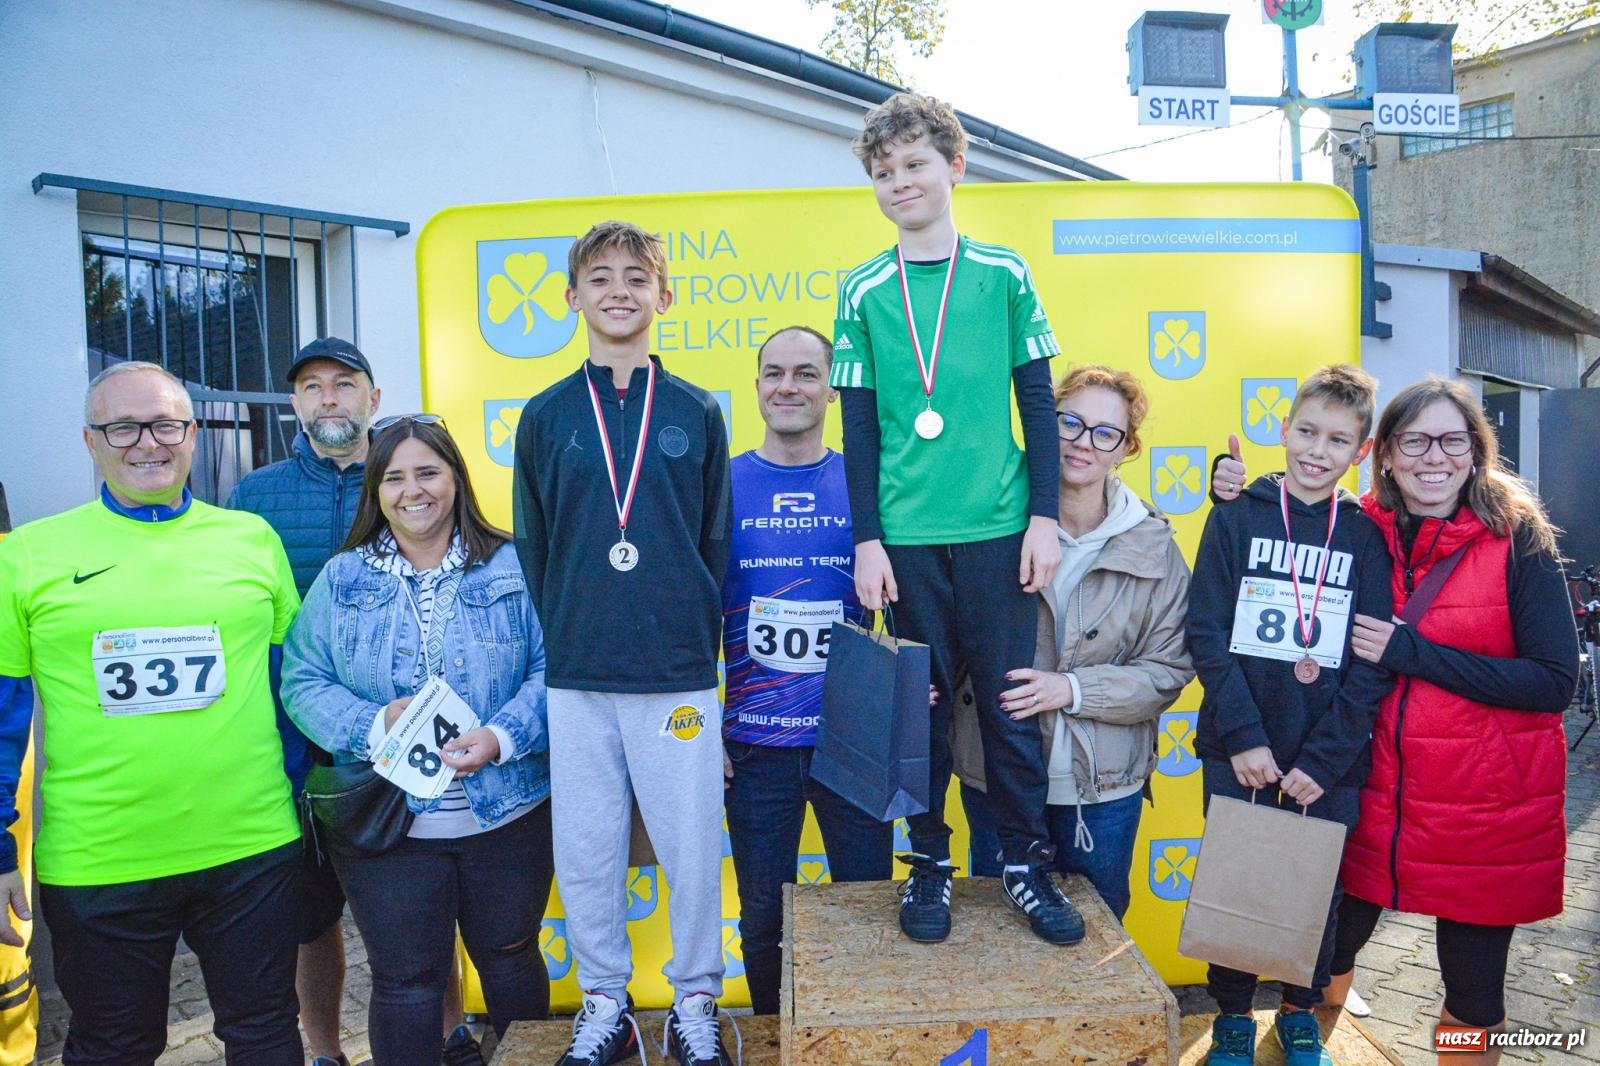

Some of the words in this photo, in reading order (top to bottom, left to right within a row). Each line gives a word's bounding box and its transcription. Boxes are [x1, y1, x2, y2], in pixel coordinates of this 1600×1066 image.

[1149, 97, 1219, 121] START
[1378, 98, 1456, 126] GOŚCIE
[667, 229, 737, 262] INA
[1059, 230, 1297, 248] www.pietrowicewielkie.com.pl
[667, 269, 850, 306] TROWIC
[656, 317, 768, 352] ELKIE
[741, 516, 846, 531] FEROCITY
[618, 547, 630, 564] 2
[739, 557, 803, 569] RUNNING
[809, 556, 851, 566] TEAM
[1247, 536, 1354, 587] PUMA
[141, 634, 215, 645] www.personalbest.pl
[753, 624, 833, 660] 305
[1256, 608, 1322, 649] 80
[103, 655, 217, 701] 337
[399, 684, 441, 738] www.personalbest.pl
[738, 711, 820, 728] WWW.FEROC
[407, 713, 461, 778] 84
